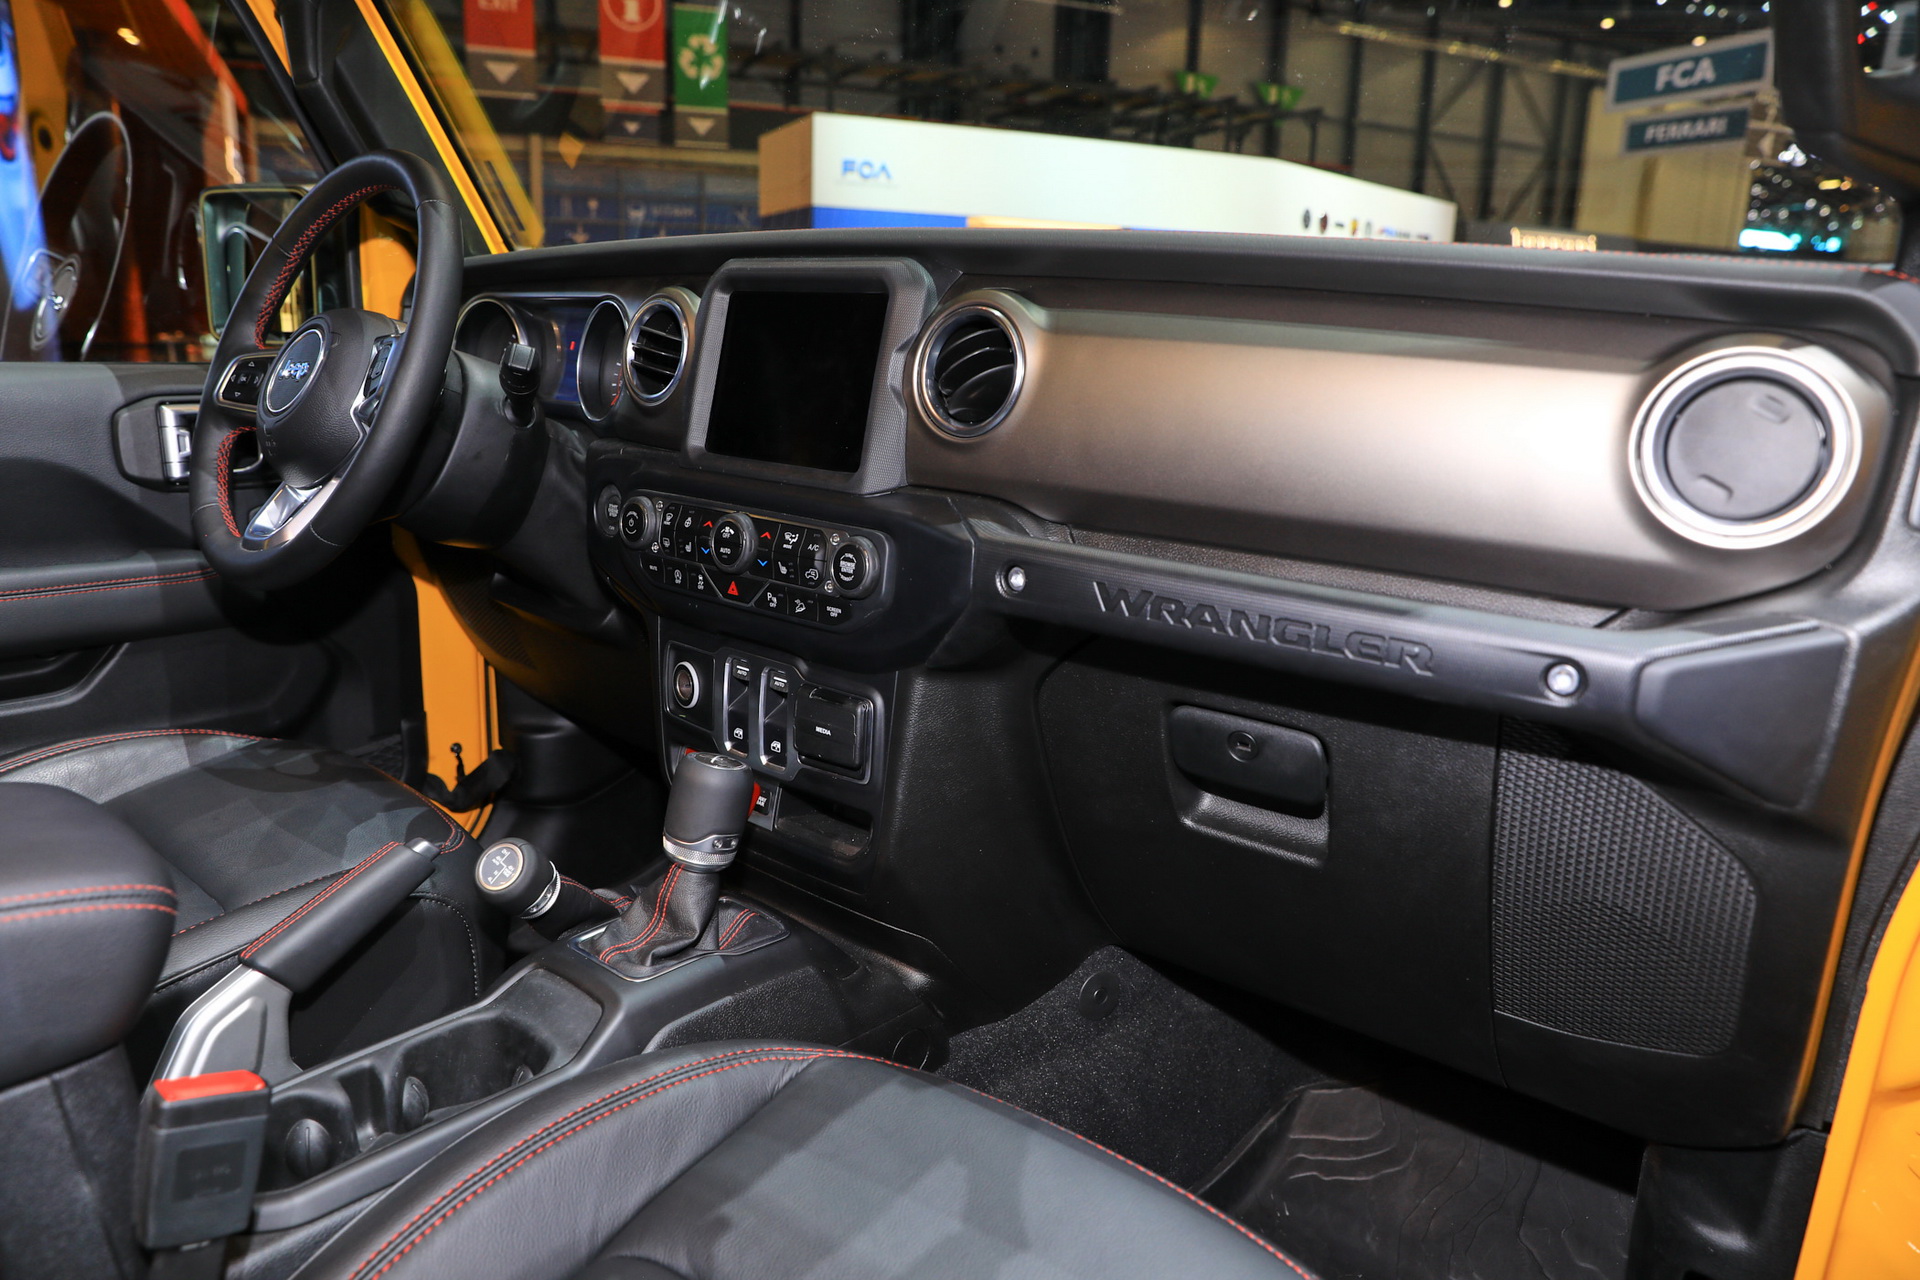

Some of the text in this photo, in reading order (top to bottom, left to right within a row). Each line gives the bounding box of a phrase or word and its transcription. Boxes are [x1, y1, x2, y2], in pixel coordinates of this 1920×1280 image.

[1655, 57, 1716, 91] FCA
[1644, 116, 1728, 143] FERRARI
[842, 158, 893, 179] FCA
[279, 359, 310, 380] Jeep
[807, 543, 820, 552] A/C
[826, 605, 842, 614] SCREEN
[1093, 581, 1434, 677] WRANGLER
[815, 726, 832, 736] MEDIA
